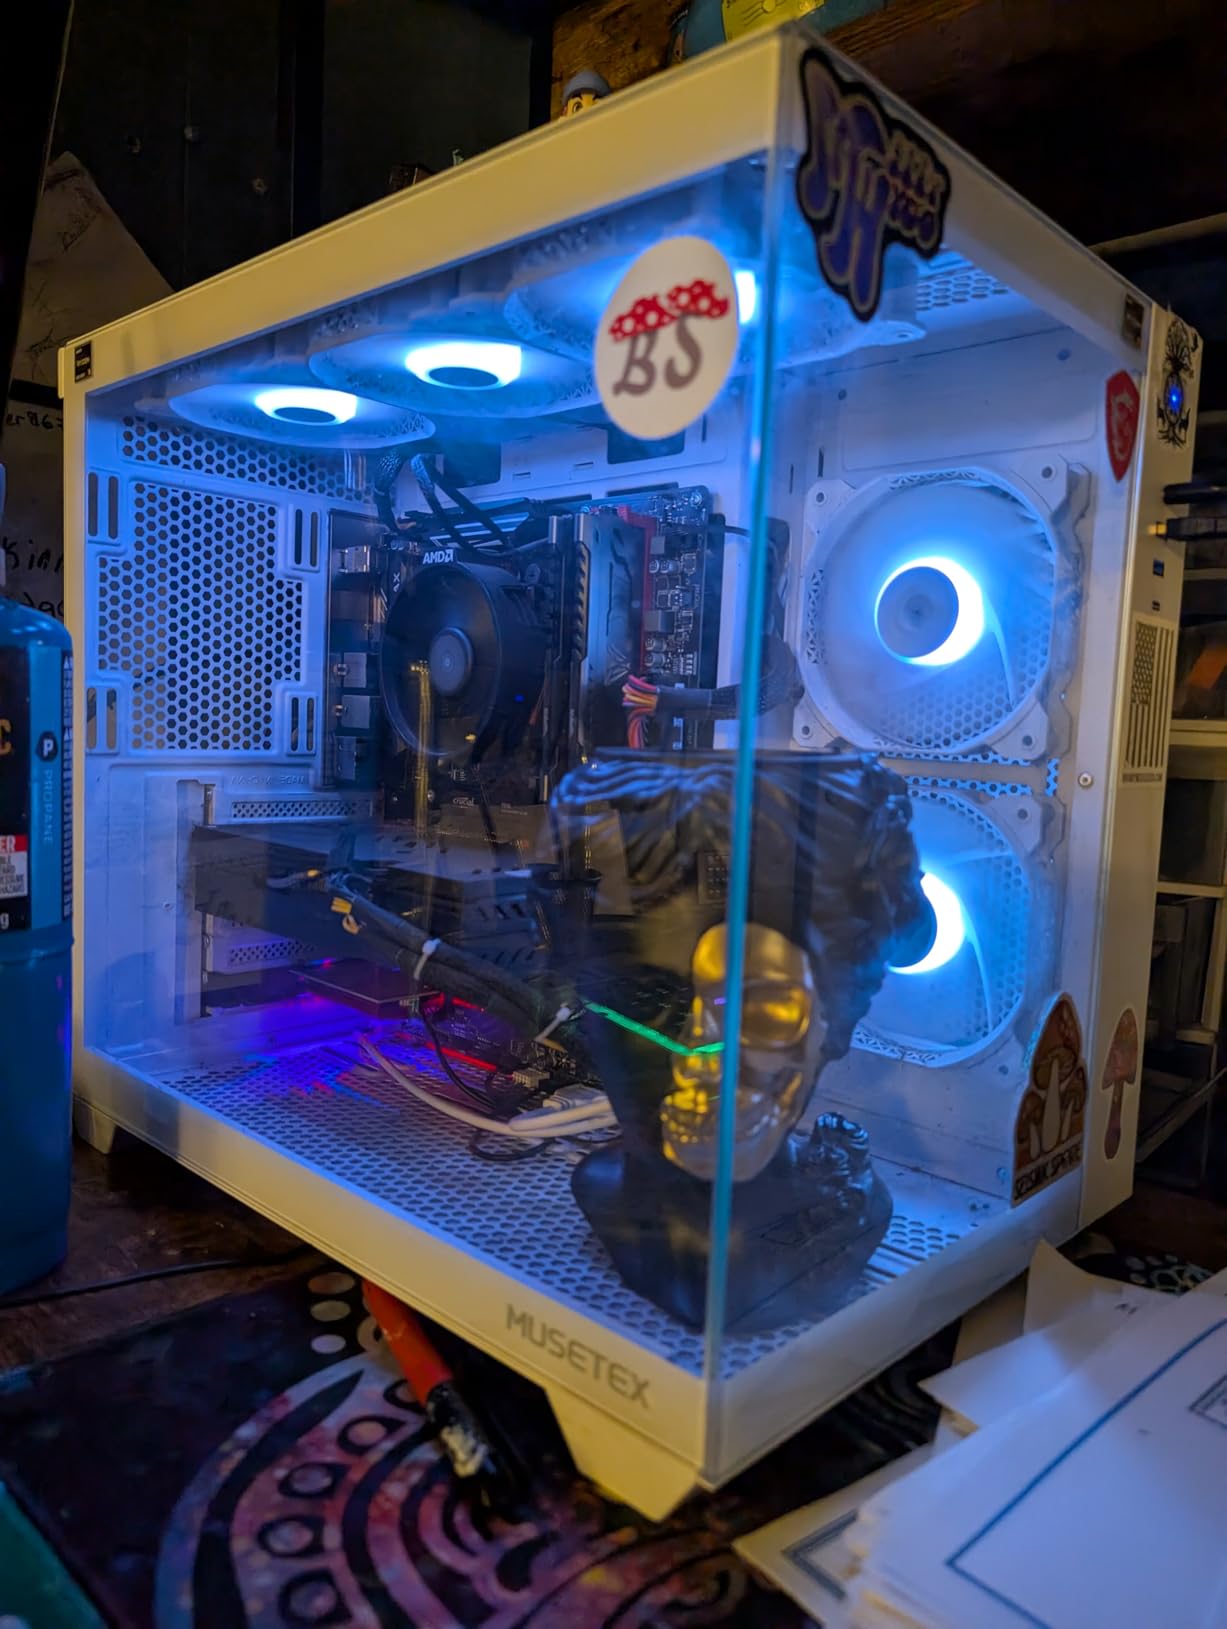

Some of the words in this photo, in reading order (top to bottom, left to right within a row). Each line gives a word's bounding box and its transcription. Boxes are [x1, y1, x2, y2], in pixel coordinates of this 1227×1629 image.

[611, 303, 708, 396] BS
[423, 550, 449, 564] AMD
[43, 769, 54, 843] PROPANE
[506, 1303, 649, 1408] MUSETEX
